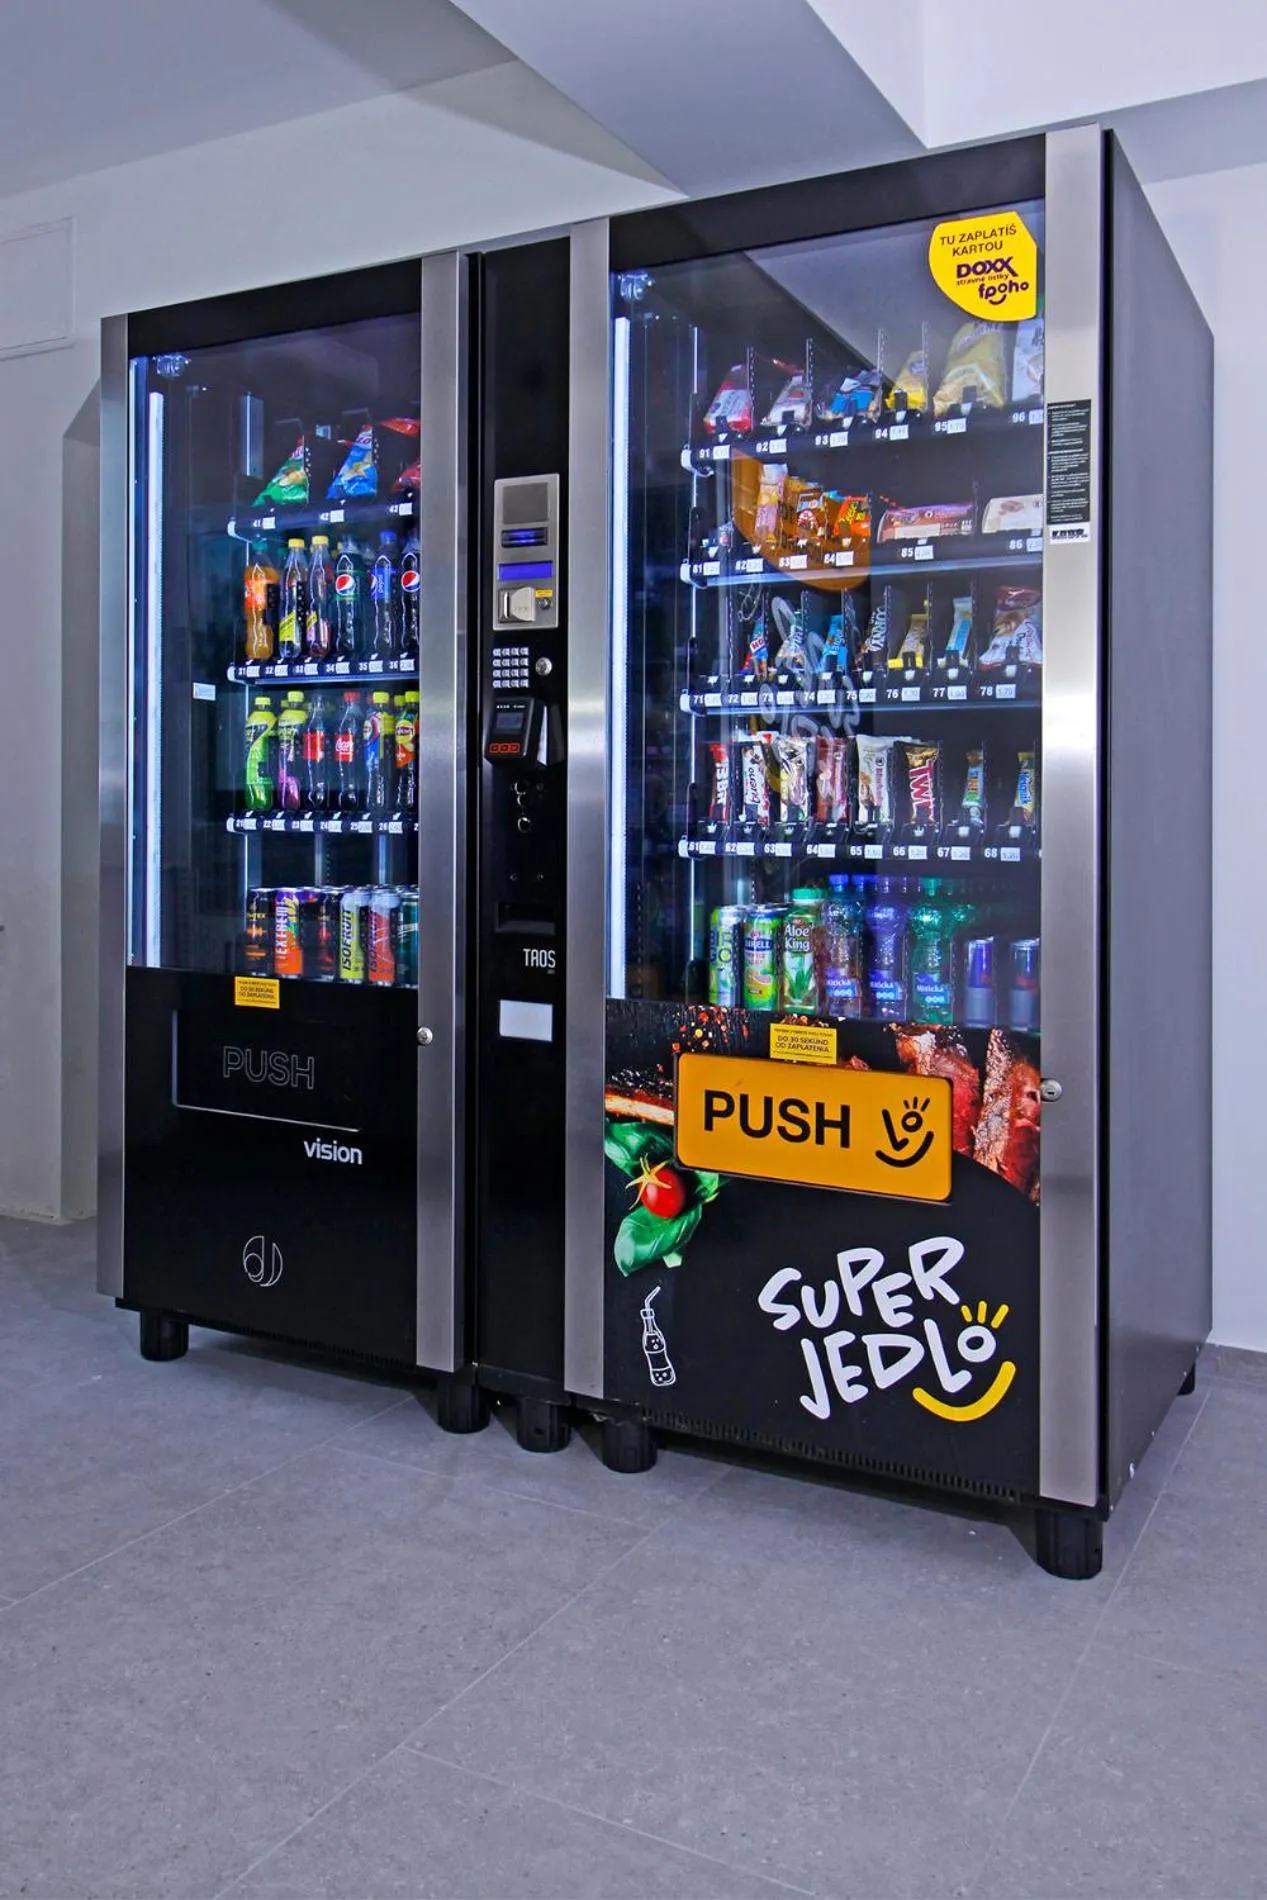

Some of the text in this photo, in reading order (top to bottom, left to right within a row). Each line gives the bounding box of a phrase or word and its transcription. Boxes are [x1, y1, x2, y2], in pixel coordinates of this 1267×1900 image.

[940, 223, 1017, 247] TU ZAPLATÍŠ
[952, 240, 1003, 257] KARTOU
[956, 256, 1018, 279] DOXX
[1012, 411, 1025, 423] 96
[934, 421, 948, 432] 95
[875, 427, 888, 439] 94
[699, 448, 710, 458] 91
[1009, 539, 1023, 549] 86
[900, 547, 913, 558] 85
[824, 553, 835, 564] 84
[804, 691, 815, 701] 74
[846, 690, 857, 700] 75
[886, 688, 899, 699] 76
[933, 687, 945, 698] 77
[980, 686, 993, 697] 78
[728, 694, 739, 704] 72
[850, 846, 862, 856] 65
[893, 846, 905, 857] 66
[937, 847, 949, 858] 67
[984, 847, 998, 858] 68
[784, 922, 810, 937] Aloe
[784, 936, 810, 952] King
[523, 948, 556, 968] TAOS
[223, 1045, 315, 1090] PUSH
[703, 1089, 851, 1149] PUSH
[303, 1137, 363, 1165] vision
[758, 1236, 964, 1331] SUPER
[799, 1318, 997, 1420] JEDLO
